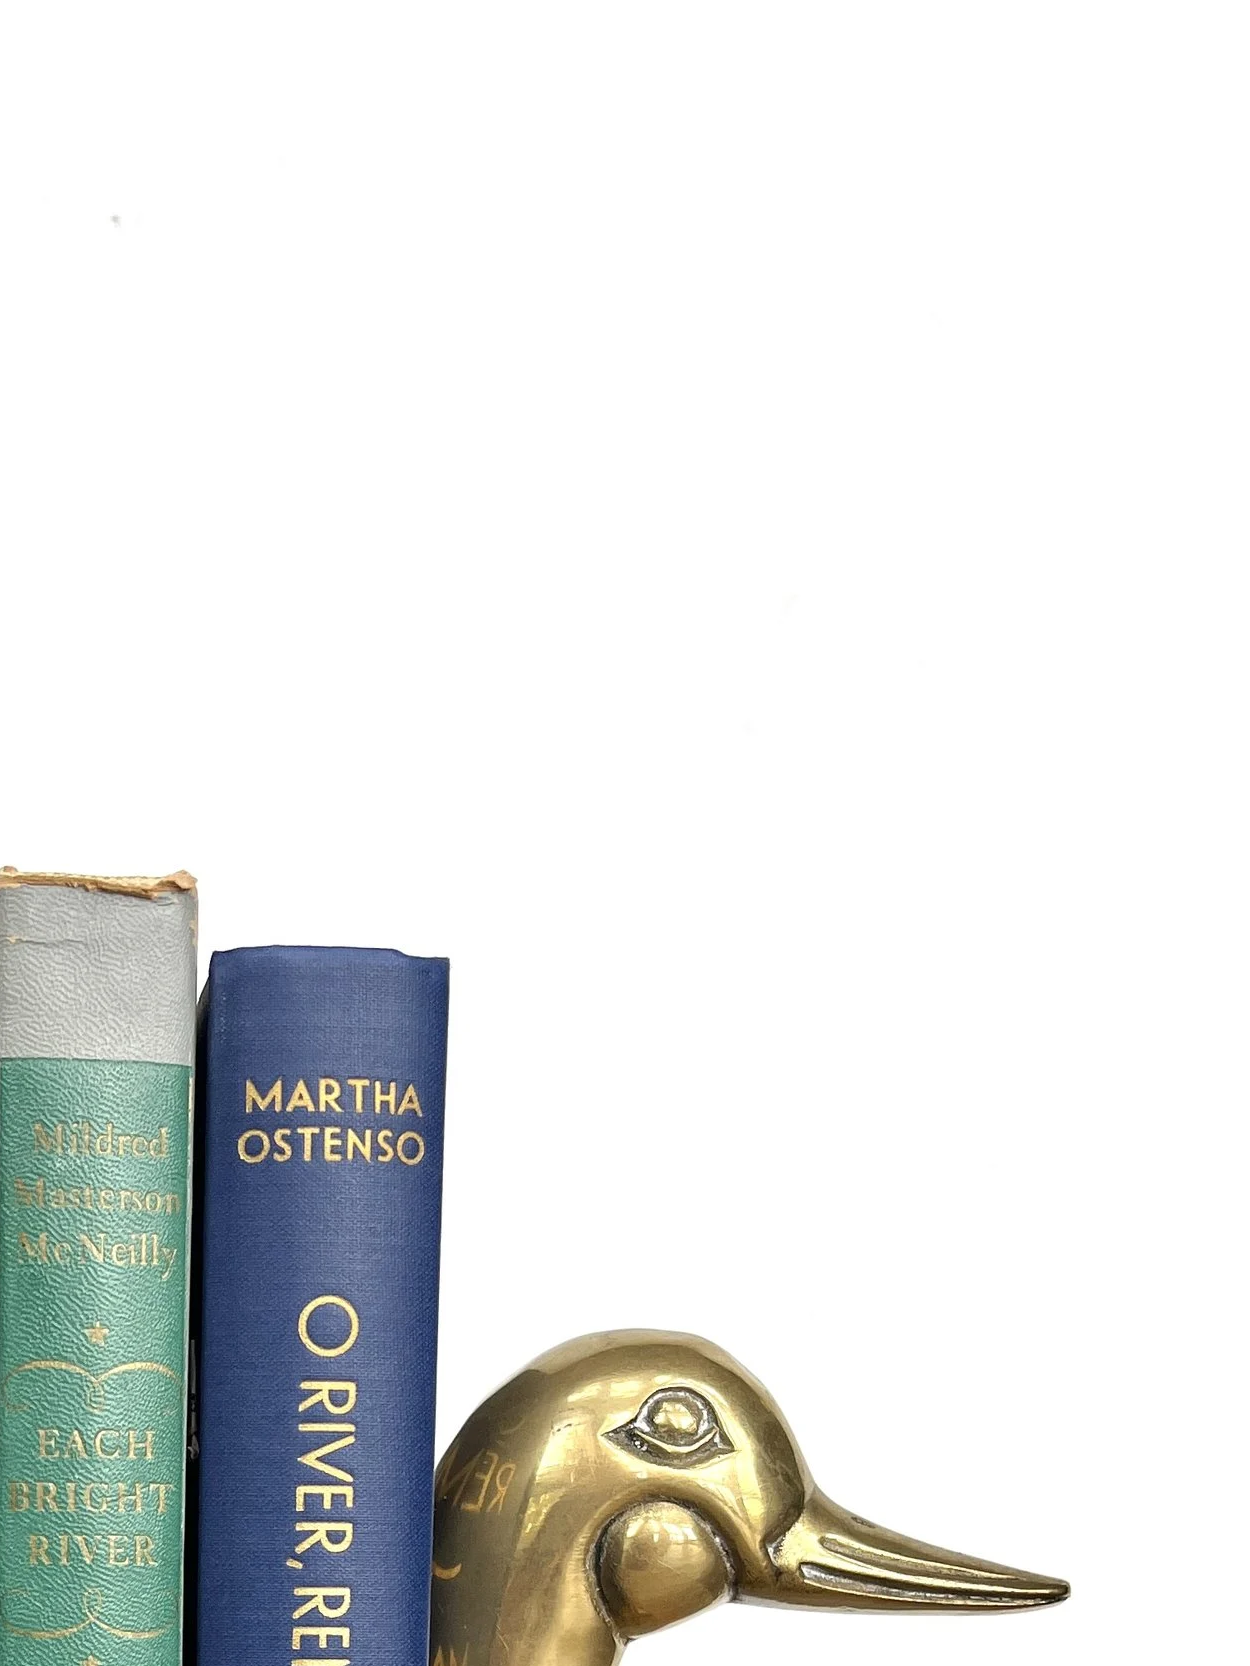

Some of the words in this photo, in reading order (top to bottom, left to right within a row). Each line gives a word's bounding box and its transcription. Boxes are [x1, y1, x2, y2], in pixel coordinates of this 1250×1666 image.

[244, 1076, 423, 1118] MARTHA
[32, 1121, 170, 1158] Mildred
[237, 1126, 426, 1166] OSTENSO
[14, 1176, 181, 1215] Masterson
[297, 1294, 359, 1358] O
[37, 1429, 155, 1461] EACH
[285, 1379, 357, 1570] RIVER,
[9, 1480, 176, 1514] BRIGHT
[27, 1534, 159, 1568] RIVER
